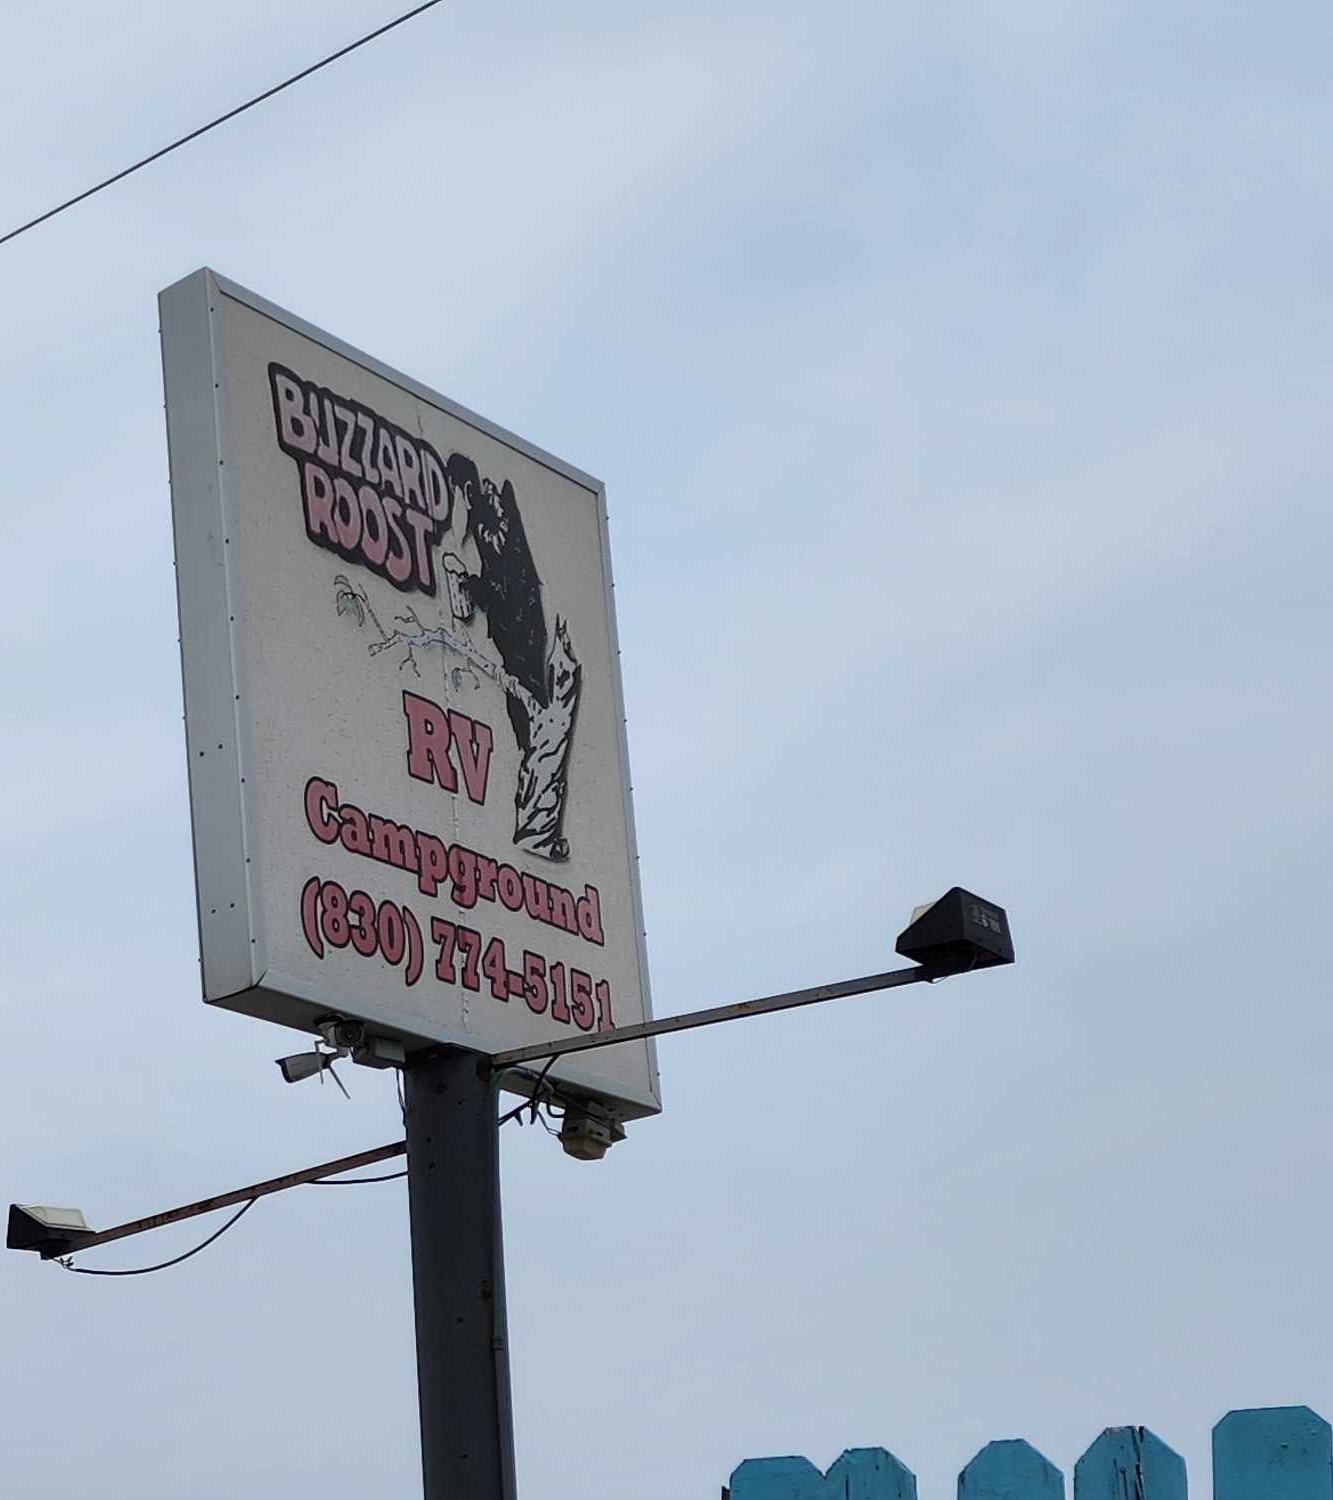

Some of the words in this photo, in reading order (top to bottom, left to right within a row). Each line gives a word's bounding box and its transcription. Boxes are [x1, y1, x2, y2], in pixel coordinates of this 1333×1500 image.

[270, 364, 453, 524] BUZZARD
[301, 460, 436, 592] ROOST
[402, 690, 494, 806] RV
[304, 776, 605, 947] Campground
[300, 876, 424, 987] (830)
[431, 916, 615, 1033] 774-5151
